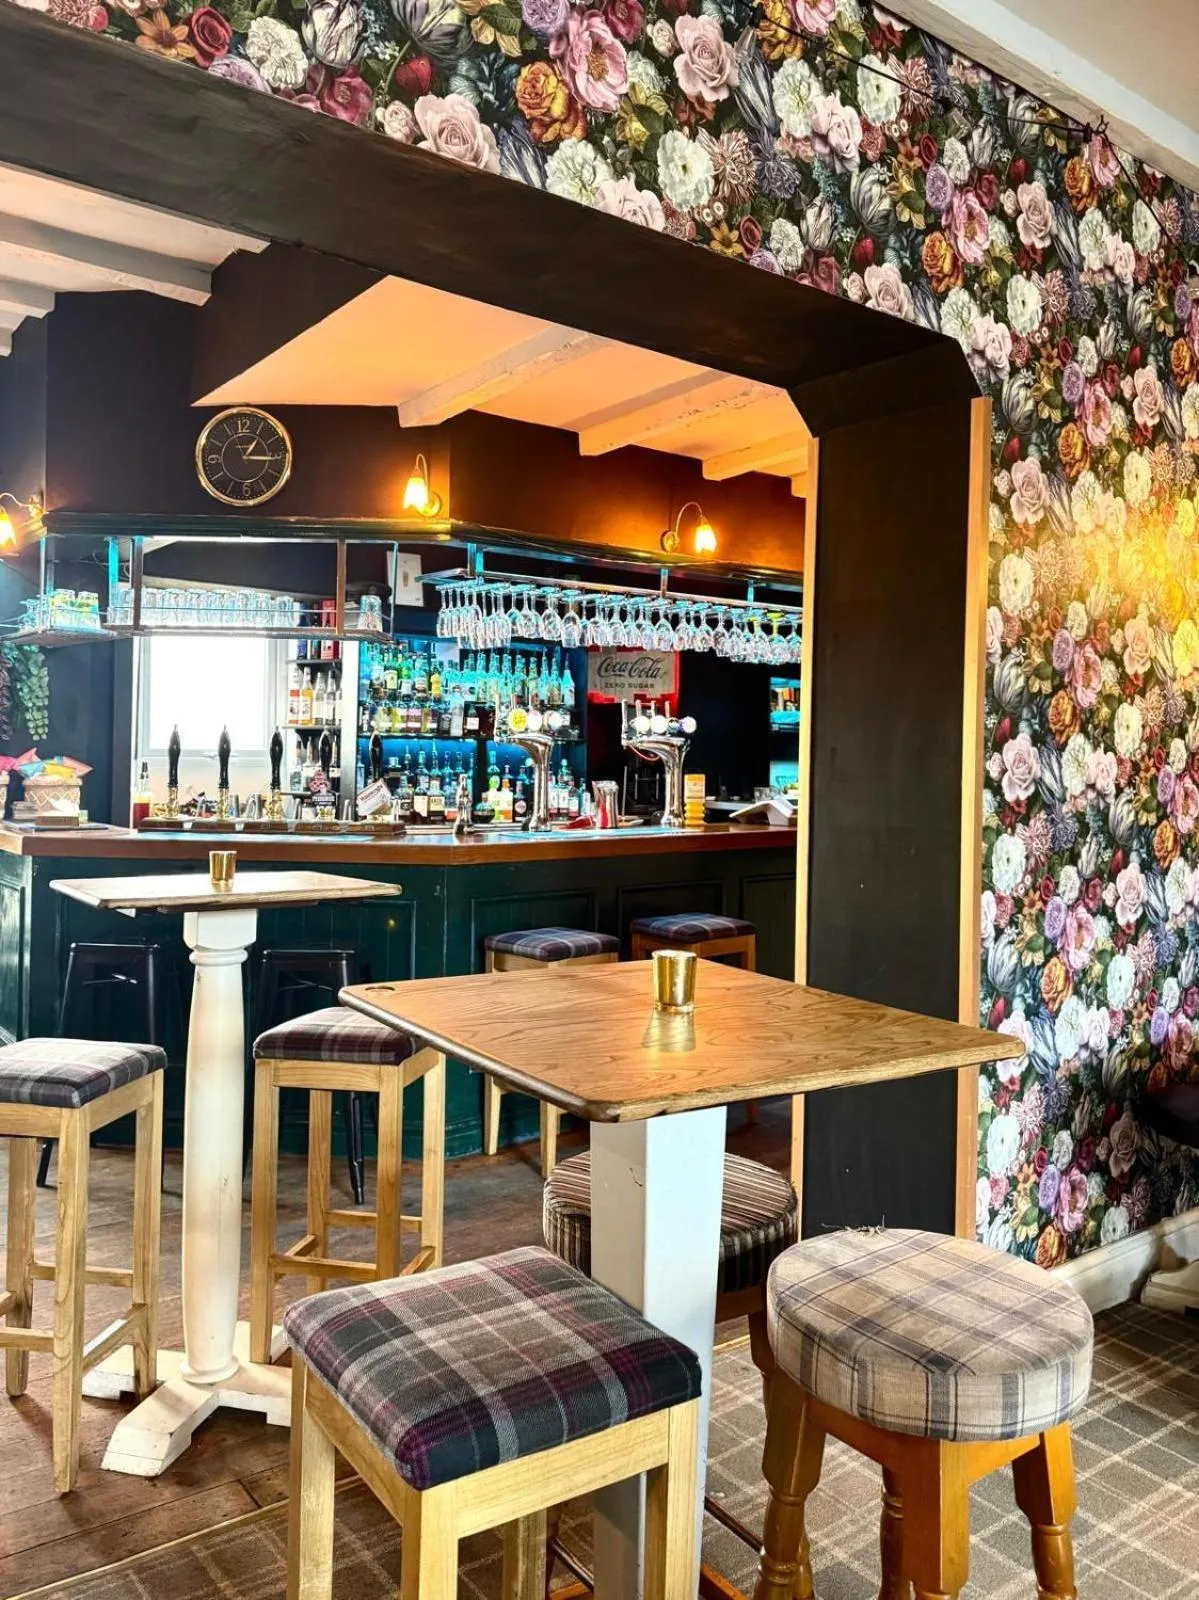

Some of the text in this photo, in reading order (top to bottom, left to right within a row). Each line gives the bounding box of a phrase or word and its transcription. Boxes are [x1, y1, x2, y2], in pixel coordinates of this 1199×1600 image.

[237, 419, 250, 432] 12
[208, 454, 221, 464] 9
[242, 483, 251, 497] 6
